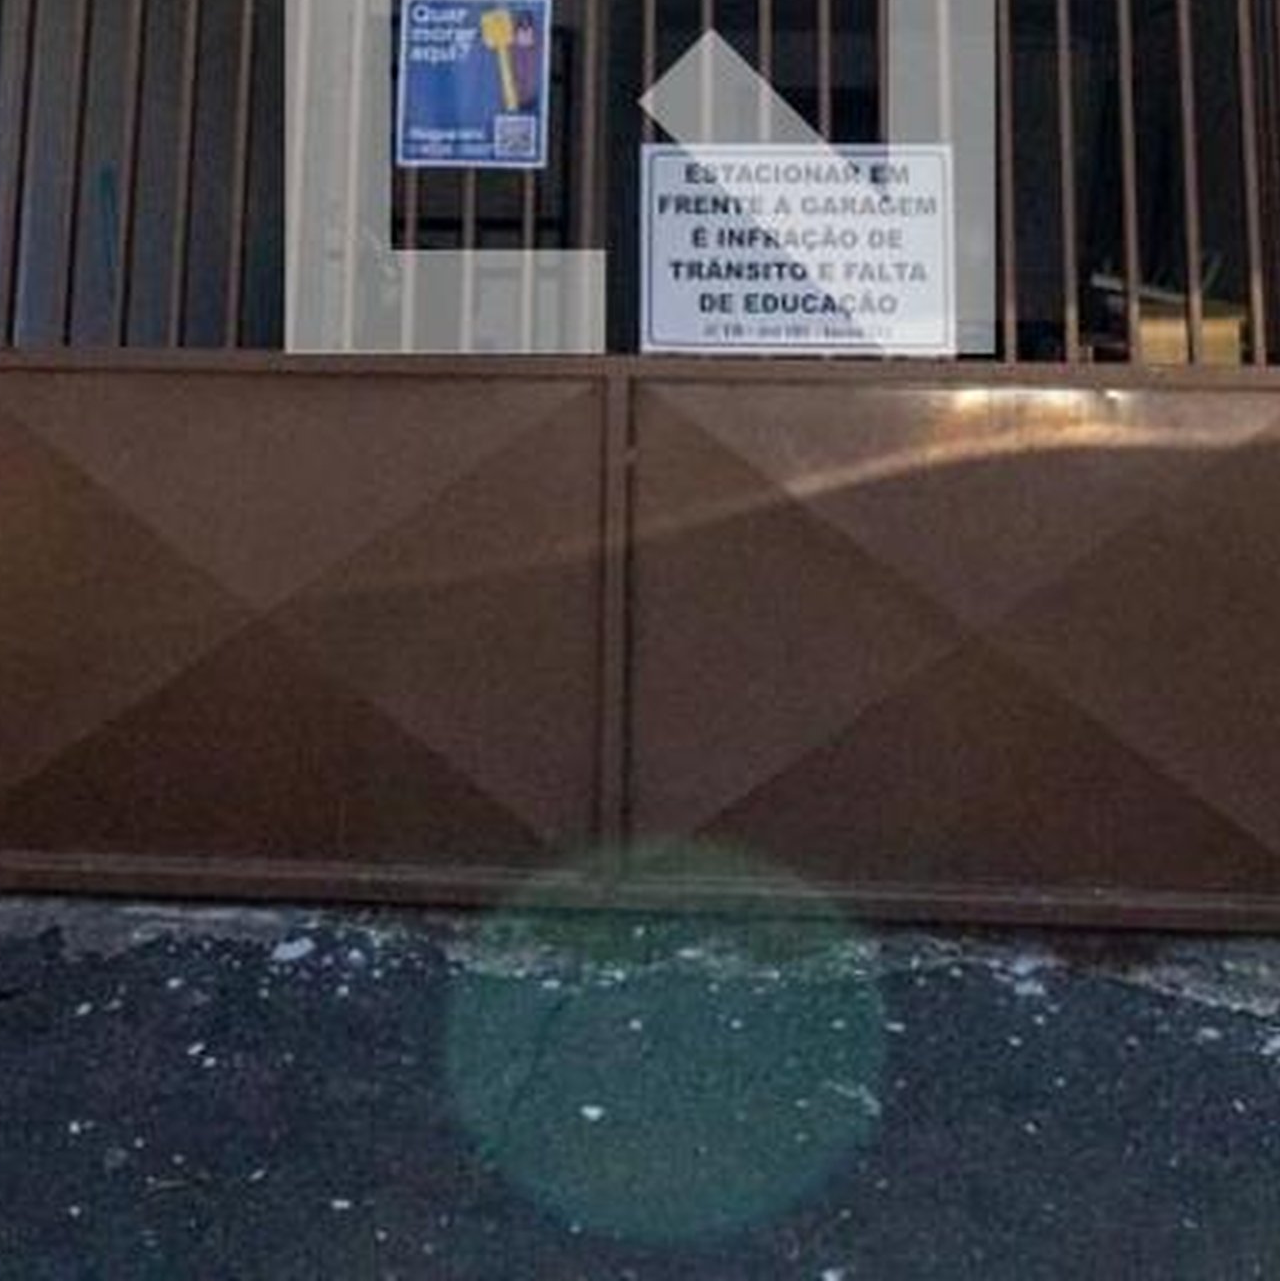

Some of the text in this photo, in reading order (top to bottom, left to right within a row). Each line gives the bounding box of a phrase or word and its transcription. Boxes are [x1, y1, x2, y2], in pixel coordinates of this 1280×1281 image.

[684, 164, 909, 185] ESTACIONAR EM
[658, 194, 938, 216] FRENTE A GARAGEM
[717, 226, 859, 251] INFRAÇÃO
[867, 229, 903, 249] DE
[819, 261, 836, 281] E
[842, 261, 928, 281] FALTA
[700, 290, 898, 319] DE EDUCAÇÃO
